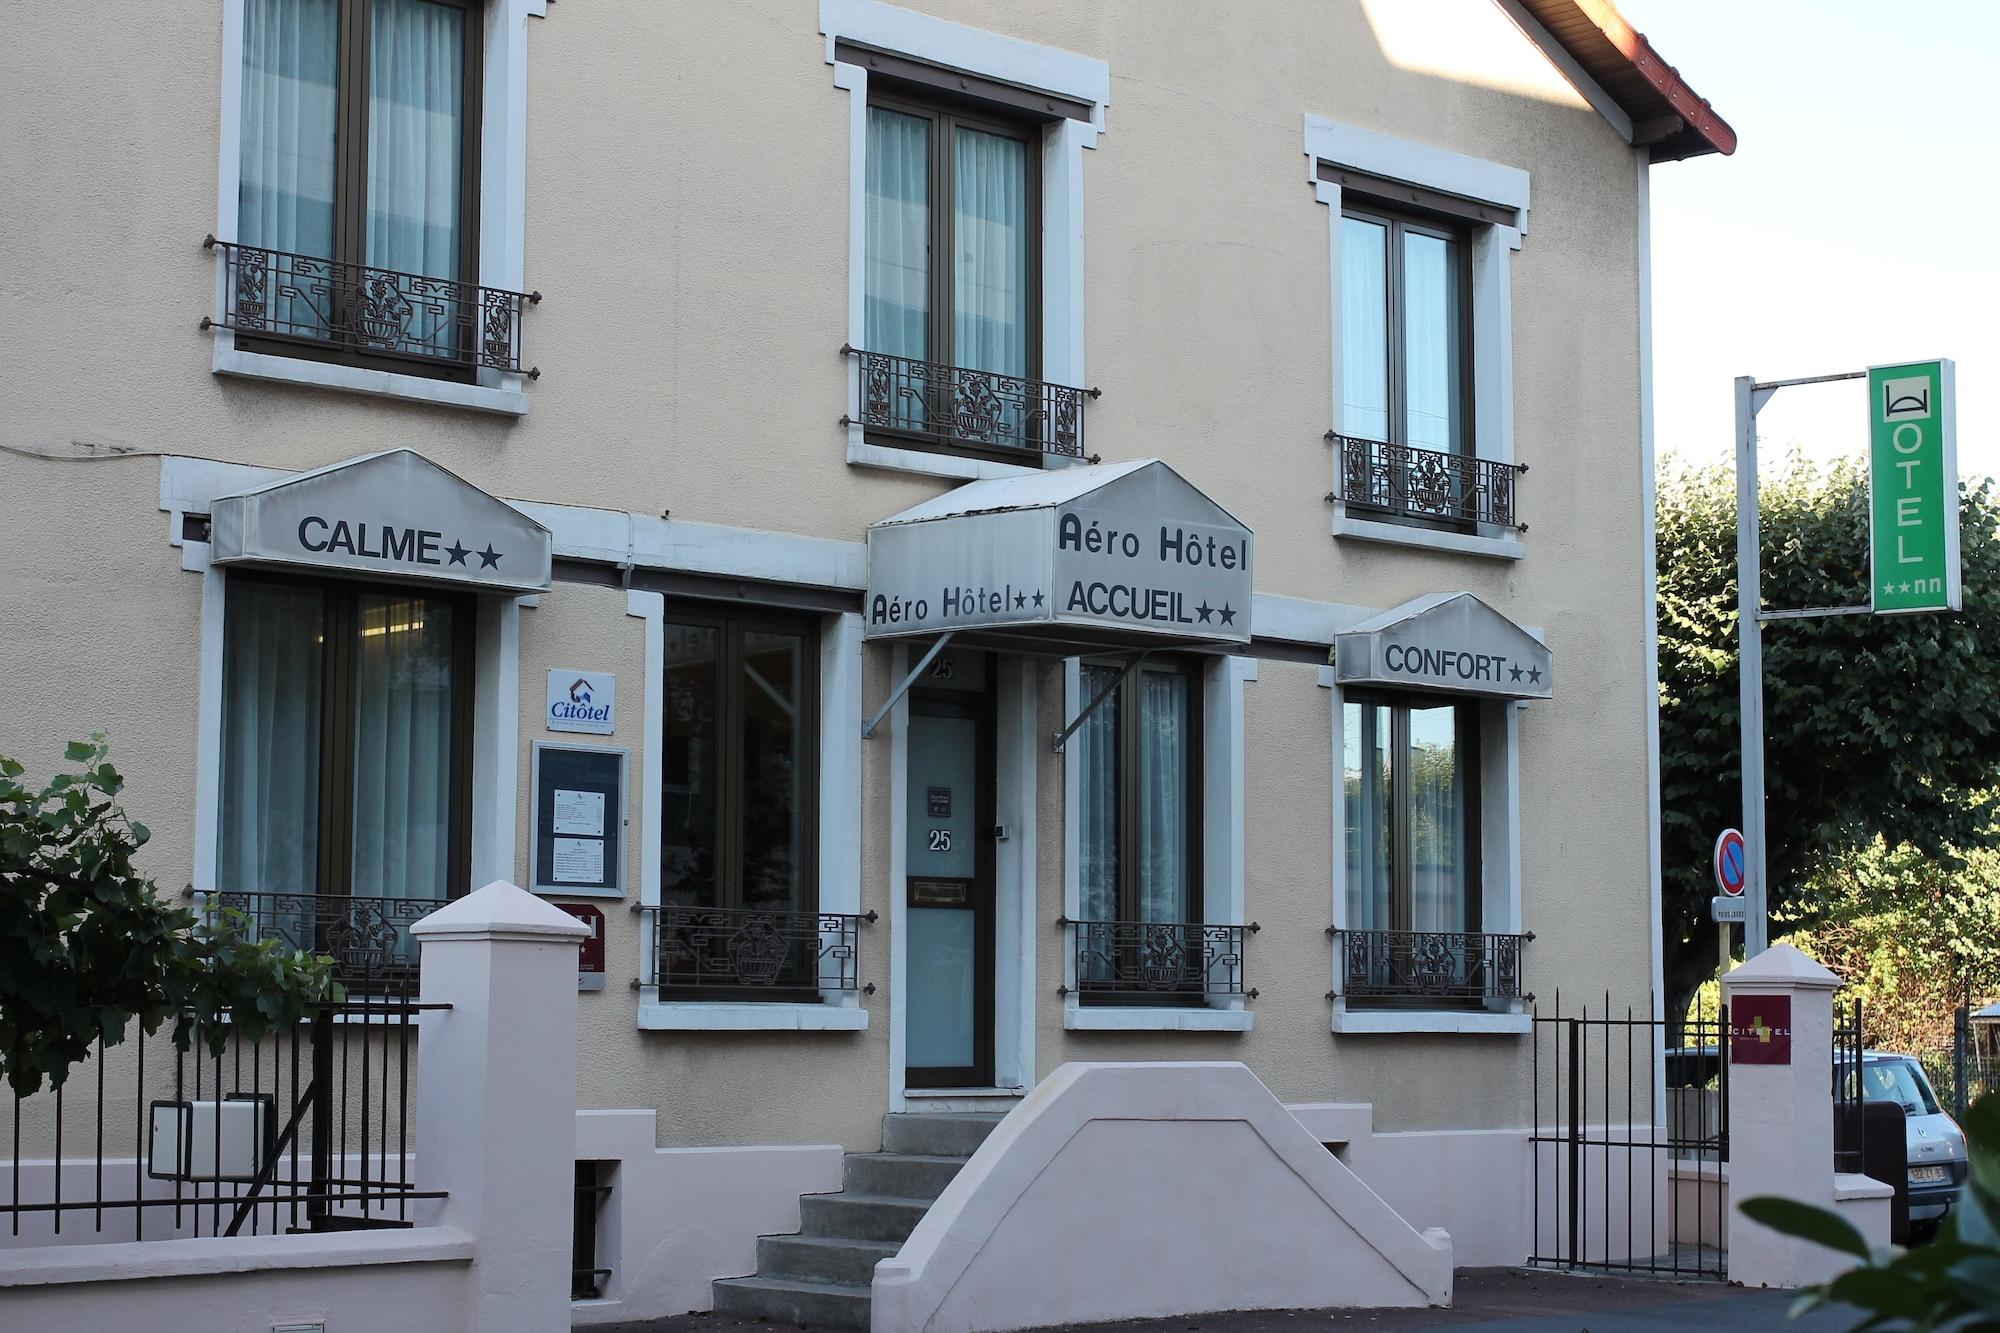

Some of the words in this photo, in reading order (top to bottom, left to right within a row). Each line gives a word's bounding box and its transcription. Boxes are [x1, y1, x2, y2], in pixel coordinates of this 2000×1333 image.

[298, 516, 442, 564] CALME
[1059, 512, 1140, 558] Aéro
[1160, 526, 1247, 571] Hôtel
[872, 593, 928, 625] Aéro
[942, 584, 1010, 617] Hôtel
[1067, 580, 1193, 624] ACCUEIL
[1914, 577, 1942, 594] nn
[931, 656, 953, 679] 25
[1385, 644, 1507, 682] CONFORT
[551, 701, 610, 721] Citôtel
[929, 830, 951, 851] 25
